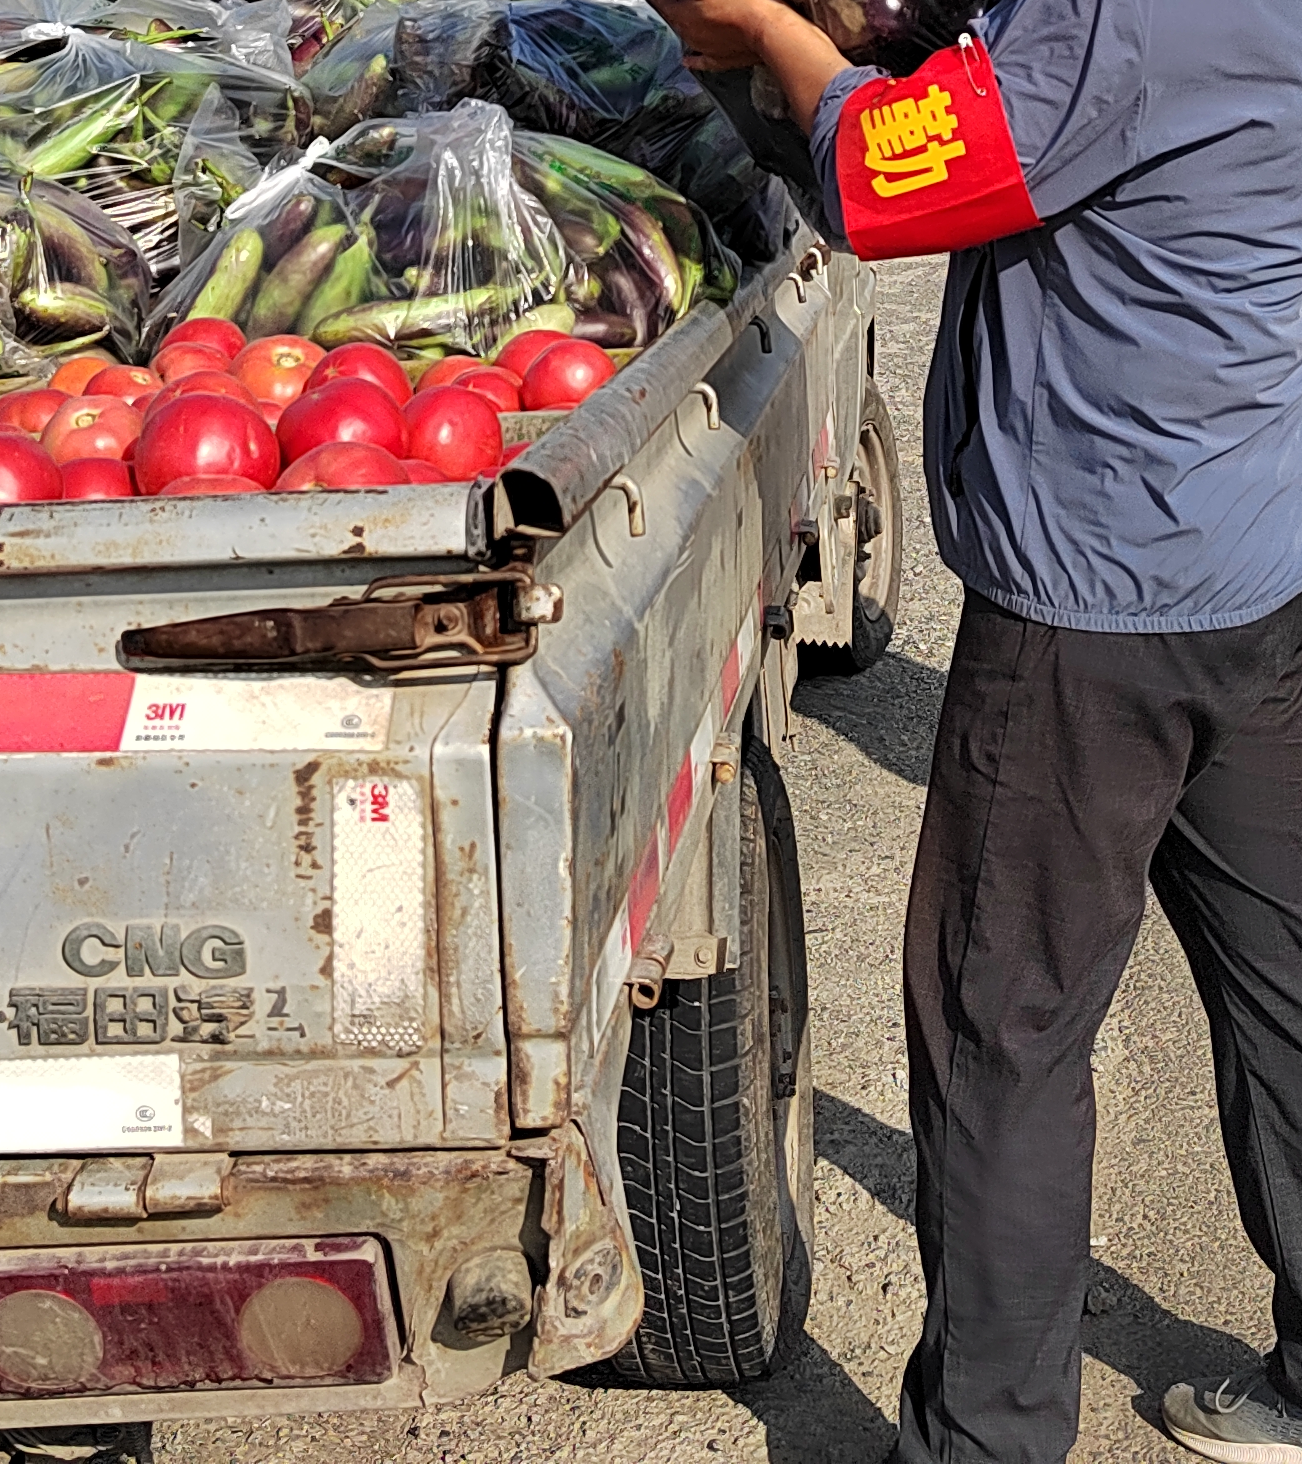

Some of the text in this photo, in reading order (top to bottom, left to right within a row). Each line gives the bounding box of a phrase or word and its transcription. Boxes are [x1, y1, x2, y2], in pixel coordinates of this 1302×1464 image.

[145, 702, 187, 721] 3M
[370, 783, 391, 823] 3M
[61, 921, 248, 980] CNG
